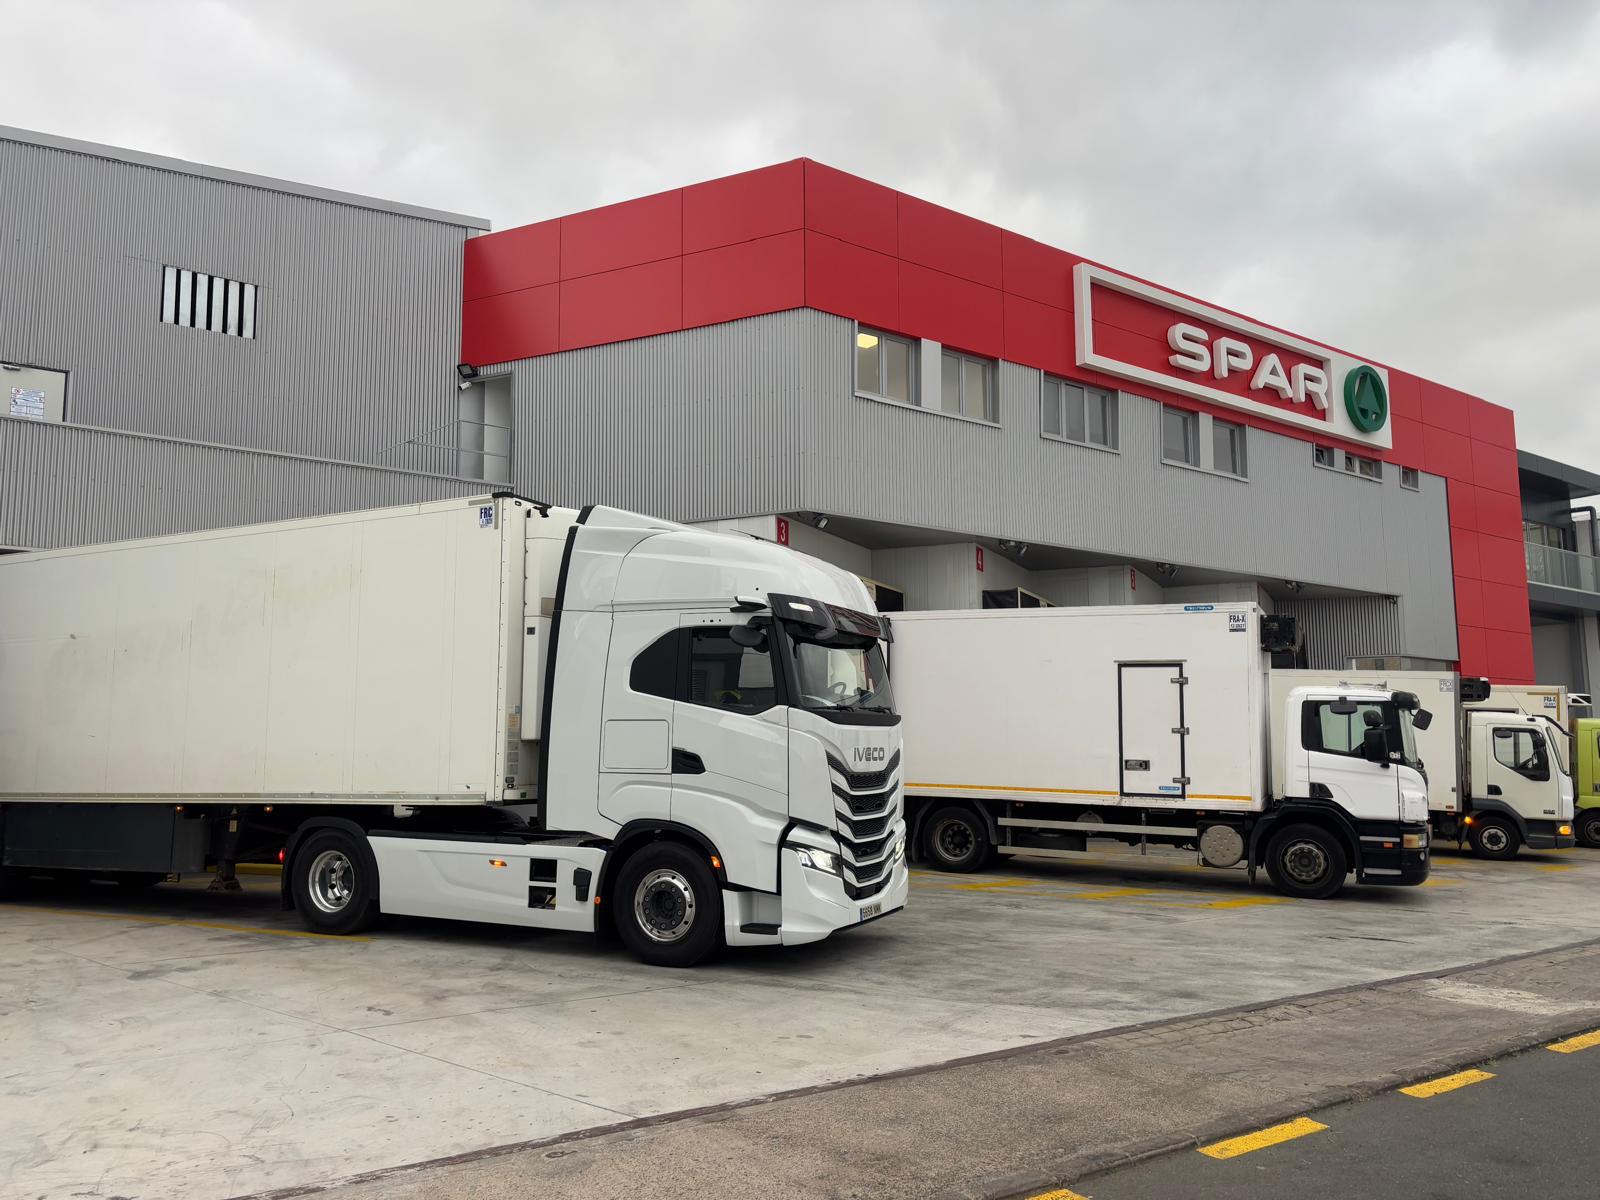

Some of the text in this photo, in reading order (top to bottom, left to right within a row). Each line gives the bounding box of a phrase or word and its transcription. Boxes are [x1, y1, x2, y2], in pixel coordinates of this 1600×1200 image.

[1167, 322, 1329, 410] SPAR
[480, 506, 493, 519] FRC
[780, 521, 786, 542] 3
[977, 550, 982, 569] 4
[1229, 614, 1246, 623] FRA-X
[853, 746, 885, 762] IVECO
